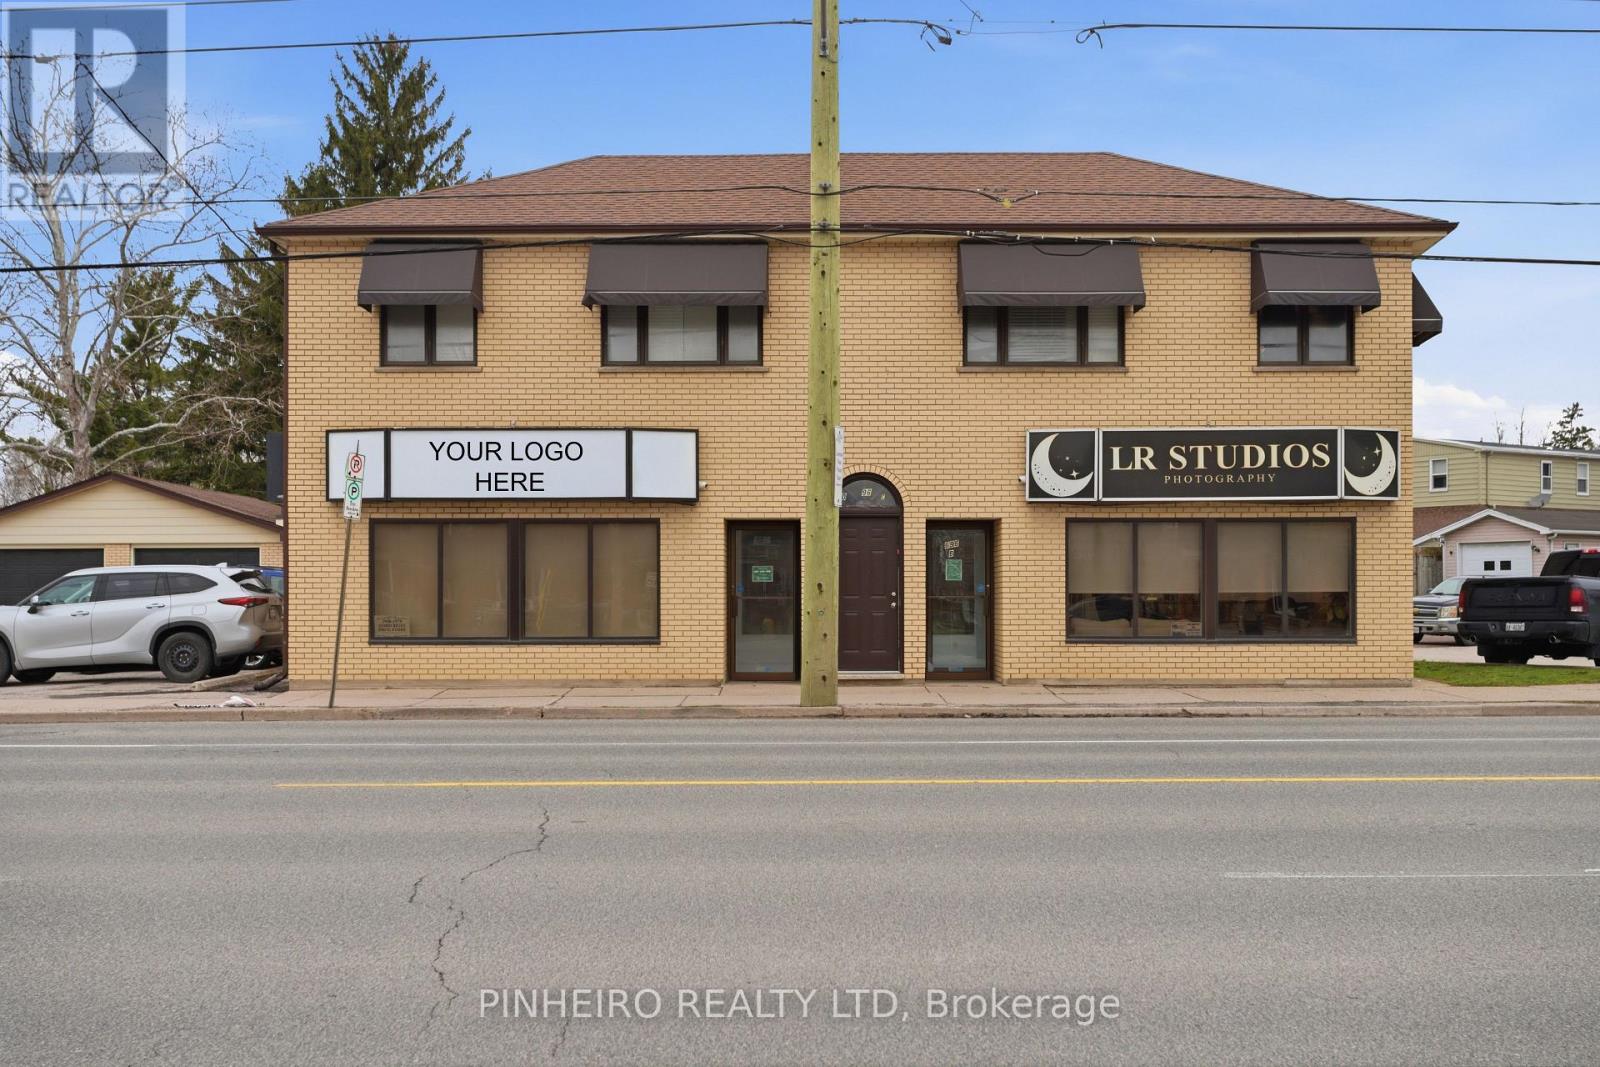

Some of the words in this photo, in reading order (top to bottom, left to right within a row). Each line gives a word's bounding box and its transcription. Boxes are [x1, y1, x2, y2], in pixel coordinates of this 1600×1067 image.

[428, 441, 502, 462] YOUR
[511, 441, 584, 462] LOGO
[1110, 446, 1158, 471] LR
[1169, 443, 1331, 470] STUDIOS
[475, 472, 545, 492] HERE
[1164, 473, 1276, 484] PHOTOGRAPHY
